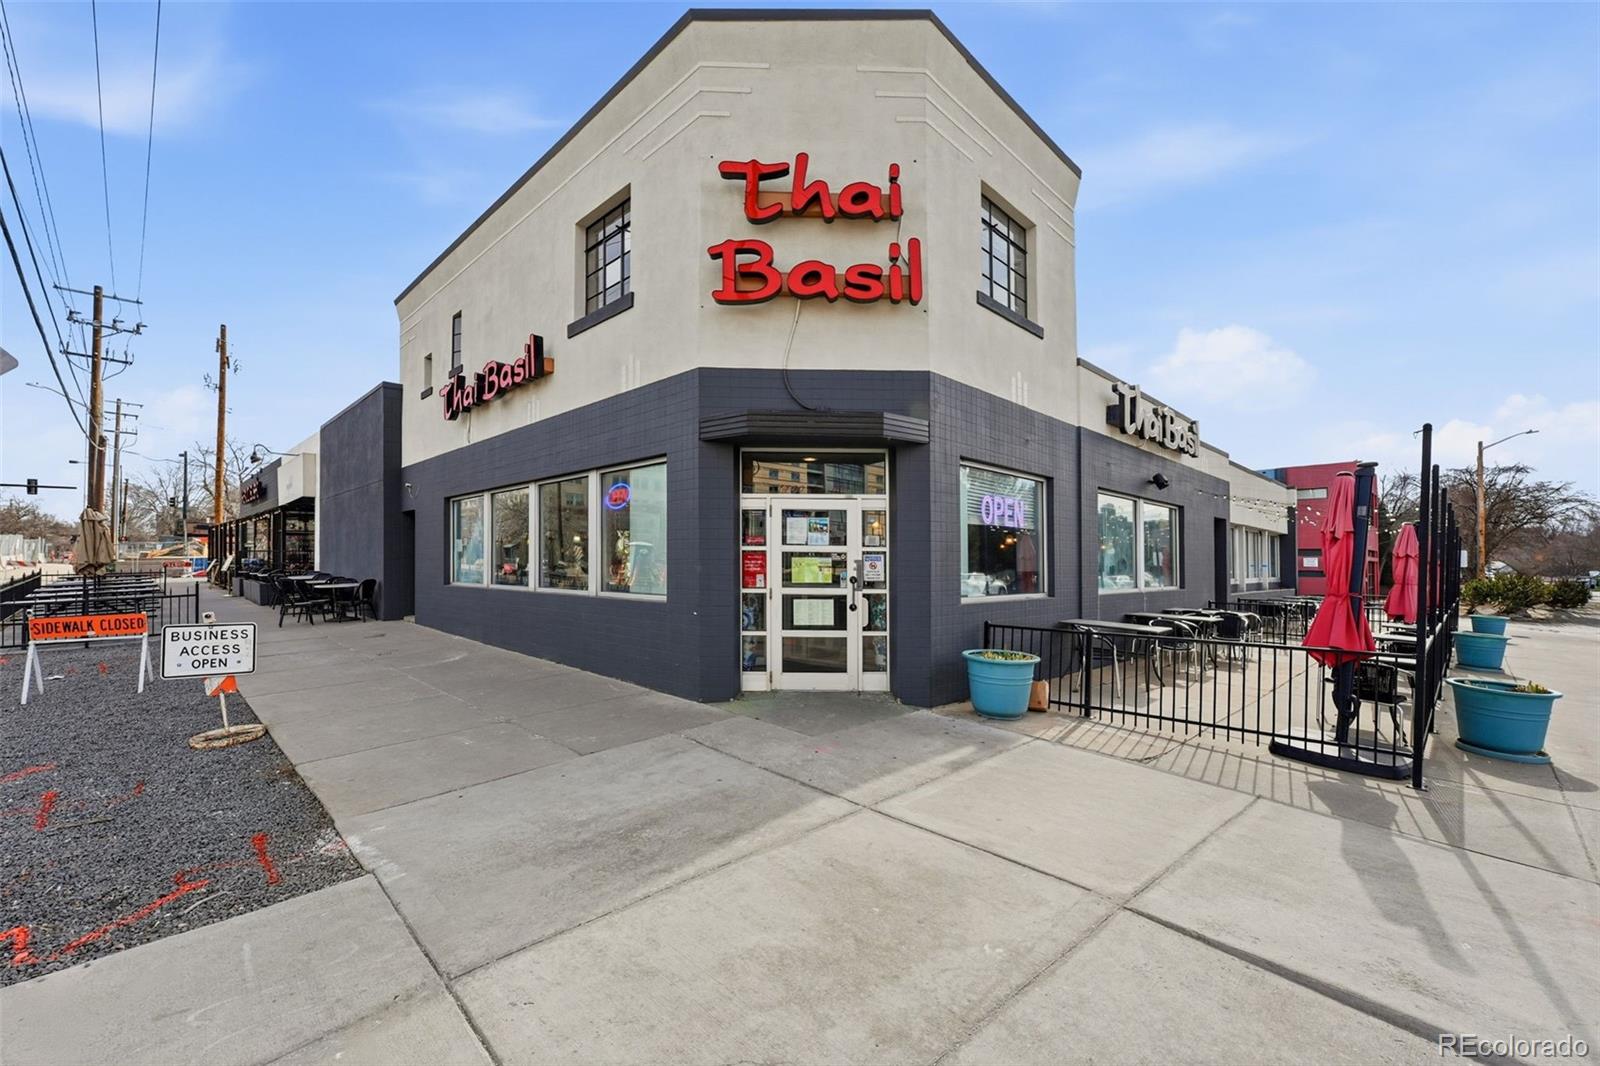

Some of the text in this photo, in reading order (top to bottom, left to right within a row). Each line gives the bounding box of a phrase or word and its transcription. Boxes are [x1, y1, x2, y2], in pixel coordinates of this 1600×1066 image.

[718, 152, 903, 224] Thai
[707, 237, 922, 305] Basil
[439, 333, 544, 420] Thai Basil
[1112, 382, 1163, 442] Thai
[981, 495, 1025, 528] OPEN
[33, 618, 144, 635] SIDEWALK CLOSED
[170, 628, 249, 642] BUSINESS
[179, 644, 241, 657] ACCESS
[191, 657, 228, 670] OPEN
